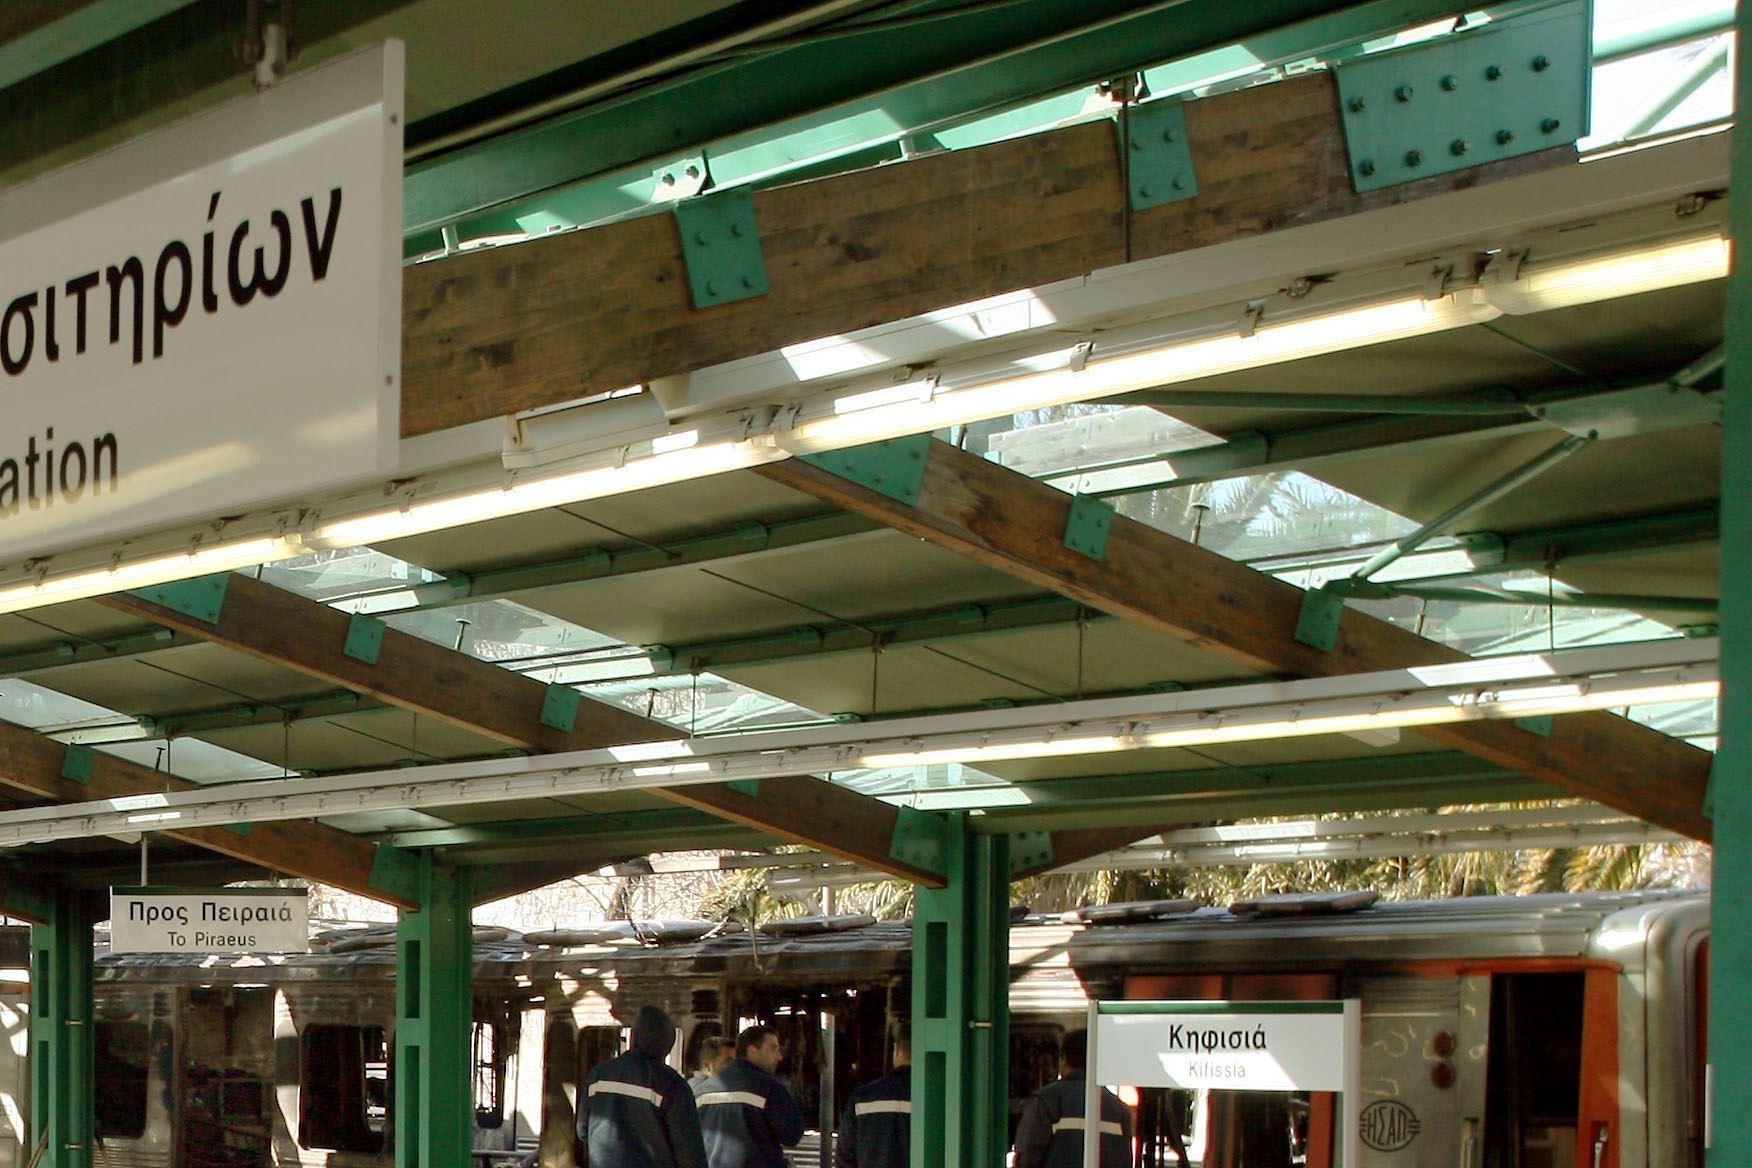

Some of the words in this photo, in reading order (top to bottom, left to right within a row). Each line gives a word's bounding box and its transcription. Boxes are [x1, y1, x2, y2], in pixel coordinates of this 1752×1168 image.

[129, 901, 188, 925] Προς
[202, 901, 293, 926] Πειραιά
[167, 931, 186, 946] To
[195, 931, 256, 947] Piraeus
[1169, 1023, 1268, 1054] Κηφισιά
[1188, 1060, 1246, 1079] Kifissia
[1365, 1105, 1408, 1146] ΗΣΑΠ
